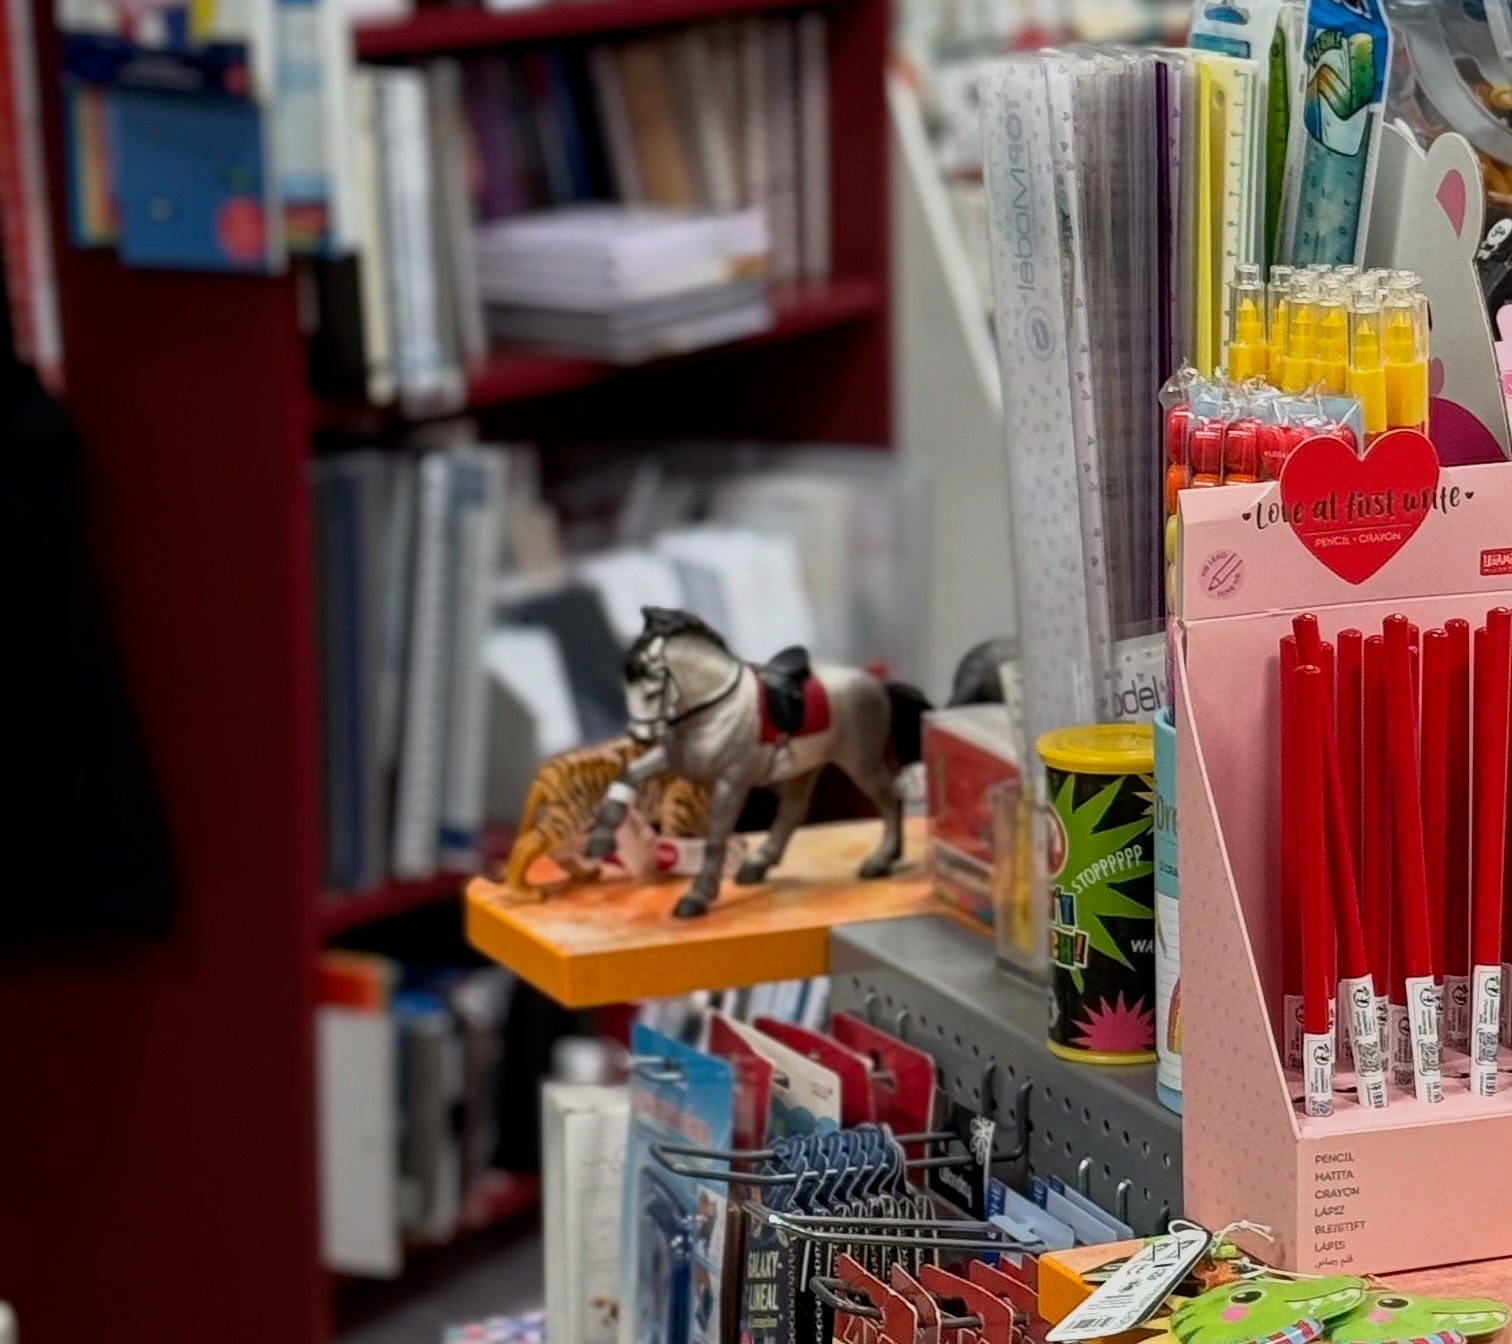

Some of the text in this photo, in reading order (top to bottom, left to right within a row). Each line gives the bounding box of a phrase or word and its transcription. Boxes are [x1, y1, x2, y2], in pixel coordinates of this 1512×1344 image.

[1315, 1152, 1354, 1165] PENCIL
[1315, 1169, 1354, 1182] MATITA
[1315, 1186, 1360, 1199] CRAYON
